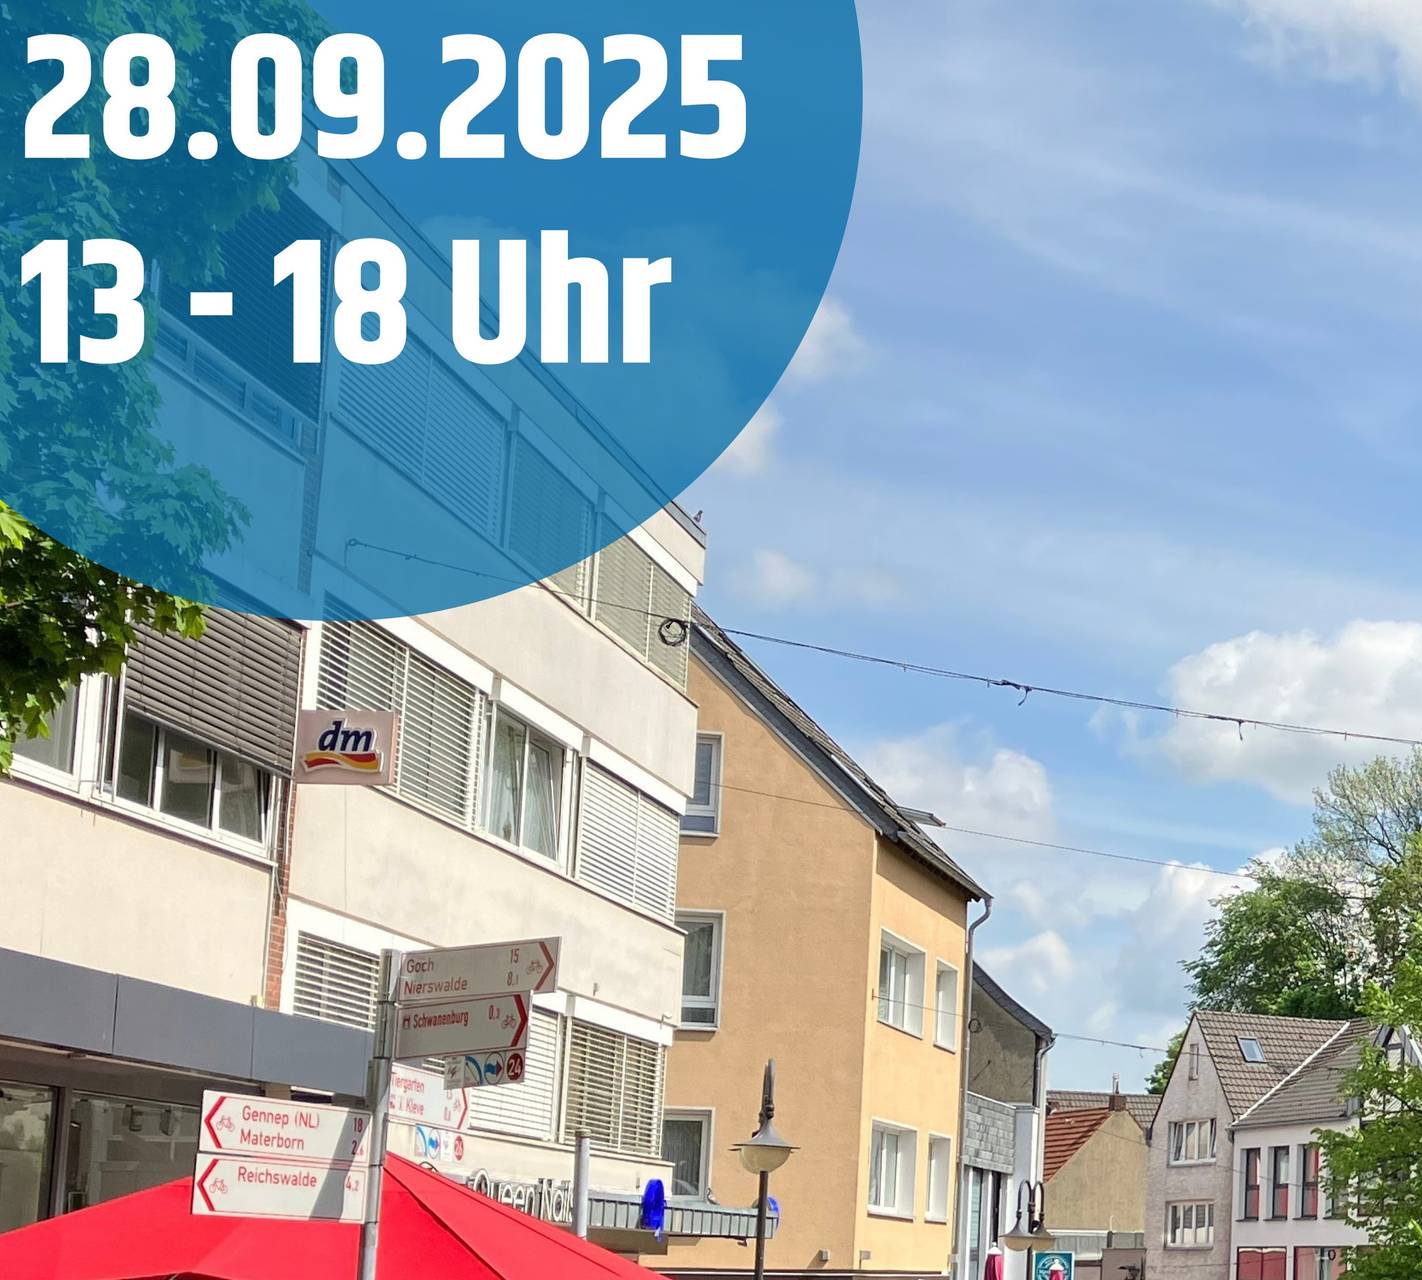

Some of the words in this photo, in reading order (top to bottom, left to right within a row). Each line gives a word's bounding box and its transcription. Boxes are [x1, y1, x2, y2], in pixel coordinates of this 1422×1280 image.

[318, 719, 374, 753] dm
[406, 957, 434, 973] Goch
[510, 948, 519, 964] 15
[404, 978, 468, 995] Nierswalde
[413, 1010, 469, 1029] Schwanenburg
[508, 1059, 521, 1076] 24
[242, 1105, 289, 1129] Gennep
[294, 1111, 320, 1129] (NL)
[353, 1117, 363, 1133] 18
[239, 1129, 304, 1150] Materborn
[237, 1166, 317, 1187] Reichswalde
